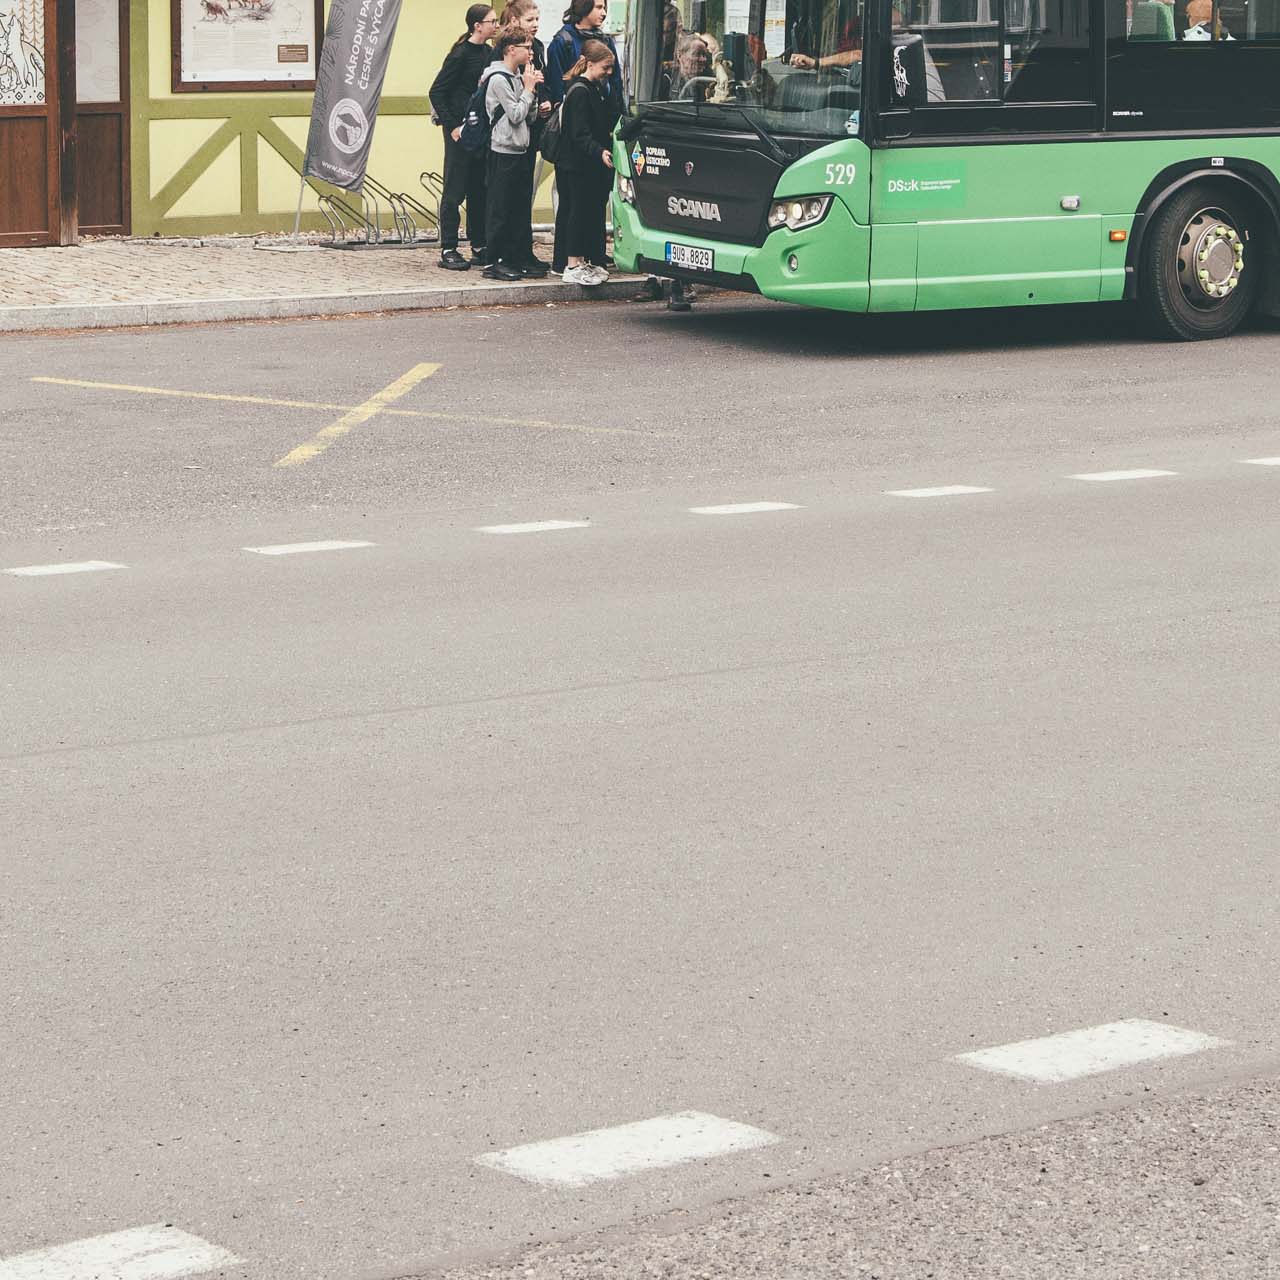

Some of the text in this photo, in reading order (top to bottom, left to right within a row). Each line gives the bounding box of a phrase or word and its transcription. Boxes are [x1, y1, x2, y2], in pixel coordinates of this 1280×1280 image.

[344, 18, 367, 86] NÁRODNÍ
[357, 46, 375, 90] ČESKÉ
[645, 146, 667, 157] DOPRAVA
[646, 165, 660, 175] KRAJE
[824, 163, 857, 185] 529
[667, 196, 722, 222] SCANIA
[672, 246, 710, 266] 9U9 8829
